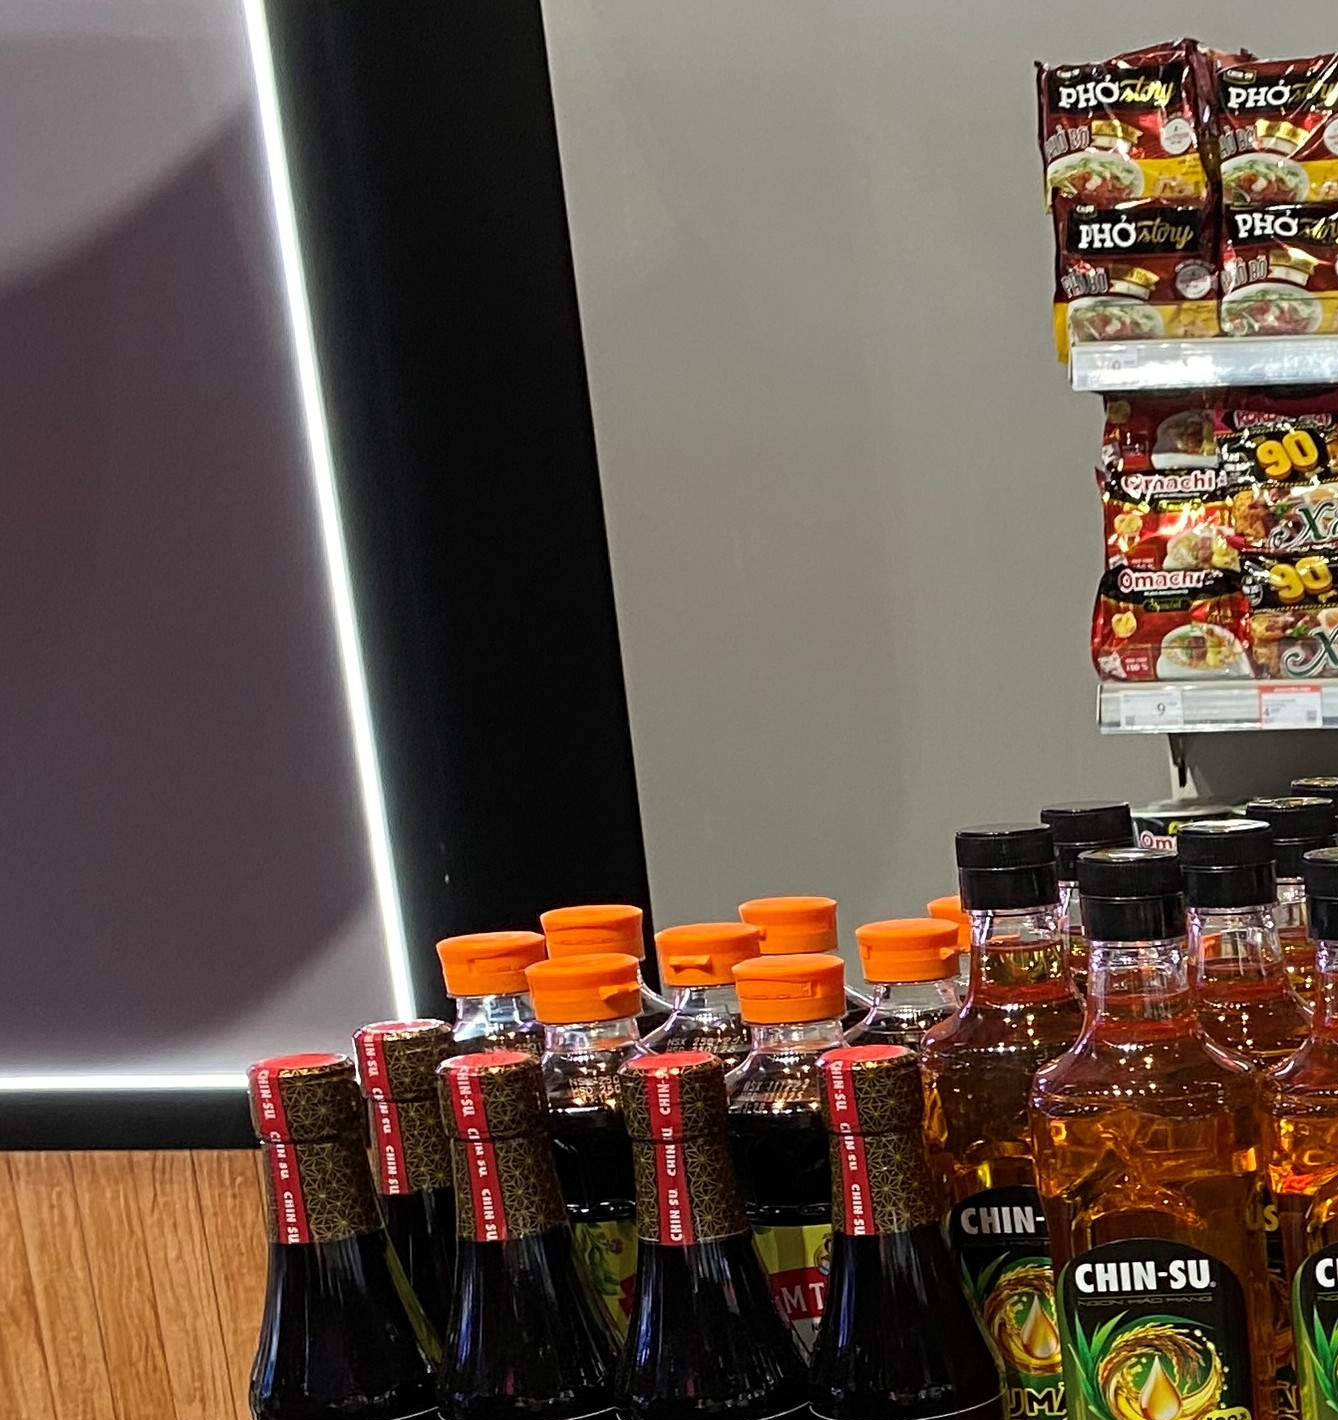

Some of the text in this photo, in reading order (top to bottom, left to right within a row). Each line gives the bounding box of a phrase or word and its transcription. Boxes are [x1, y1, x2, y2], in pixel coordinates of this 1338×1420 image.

[1078, 215, 1137, 249] PHỞ
[1256, 430, 1319, 480] 90
[1075, 1259, 1211, 1293] CHIN-SU
